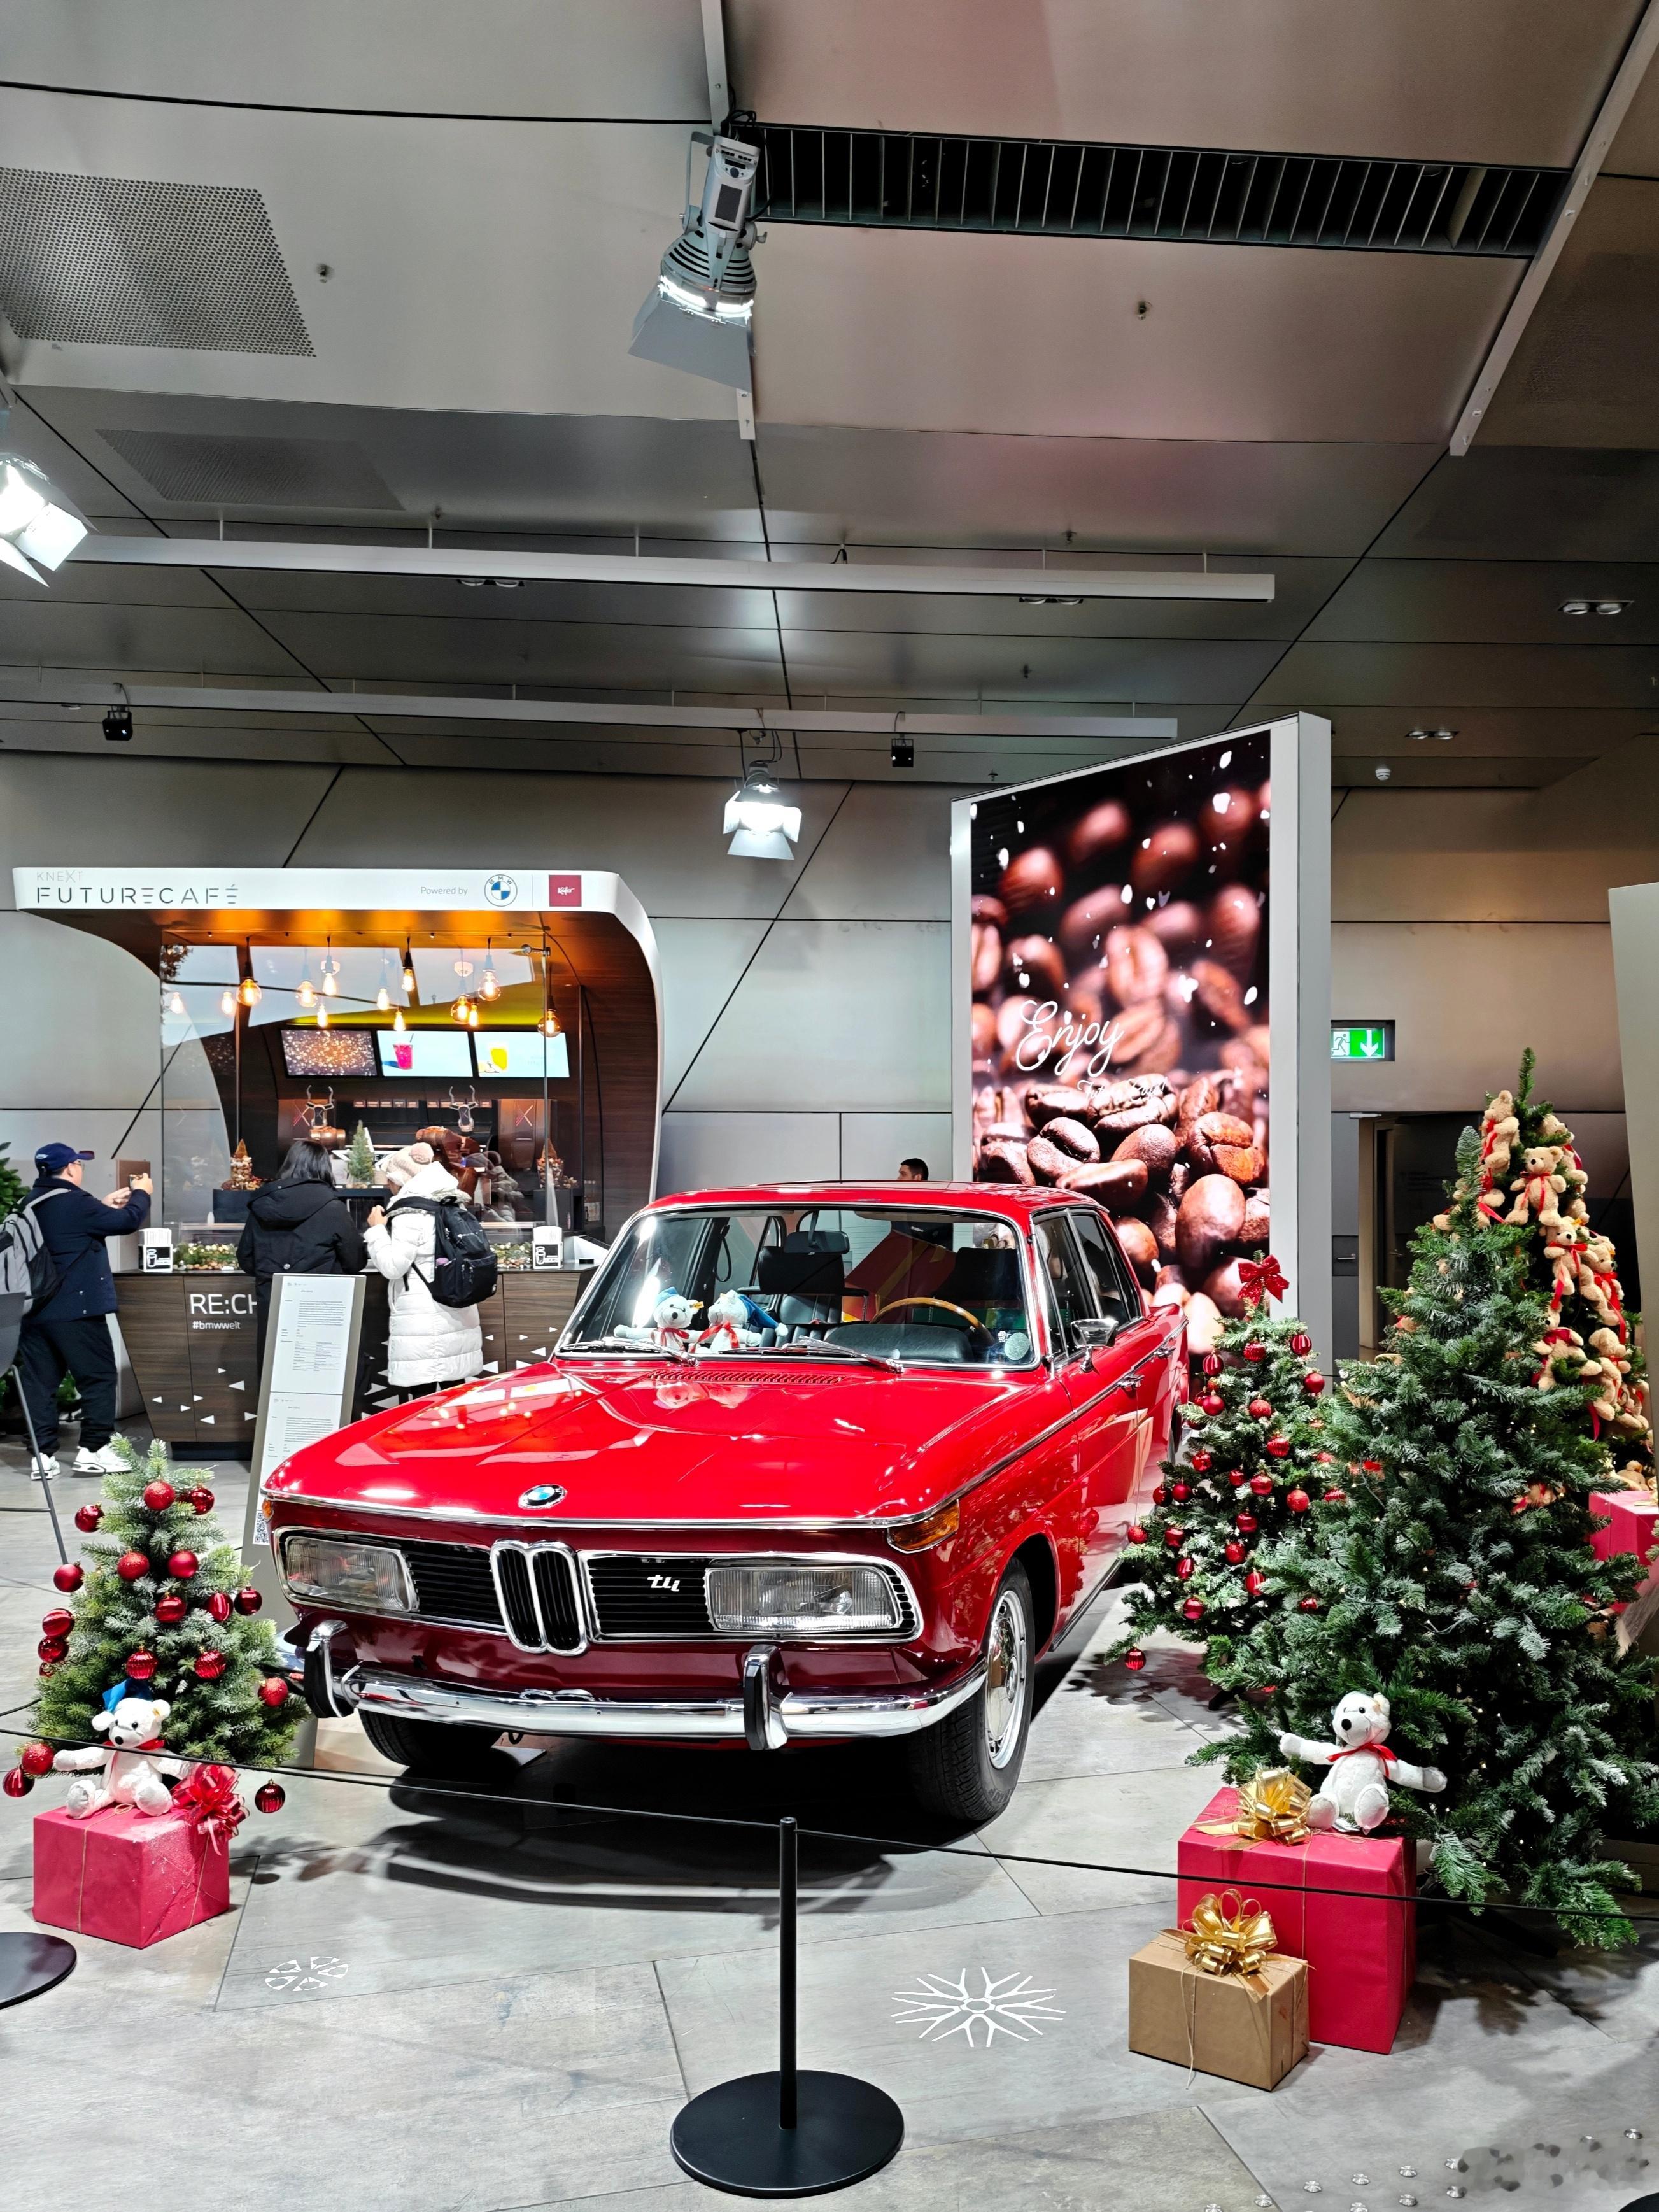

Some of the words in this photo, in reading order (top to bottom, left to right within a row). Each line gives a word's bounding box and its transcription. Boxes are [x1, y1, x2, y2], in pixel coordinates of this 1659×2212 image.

[36, 870, 83, 883] KNEXT
[421, 886, 456, 895] Powered
[458, 886, 469, 896] by
[1016, 1000, 1124, 1077] Enjoy
[192, 1320, 241, 1330] #bmwwelt
